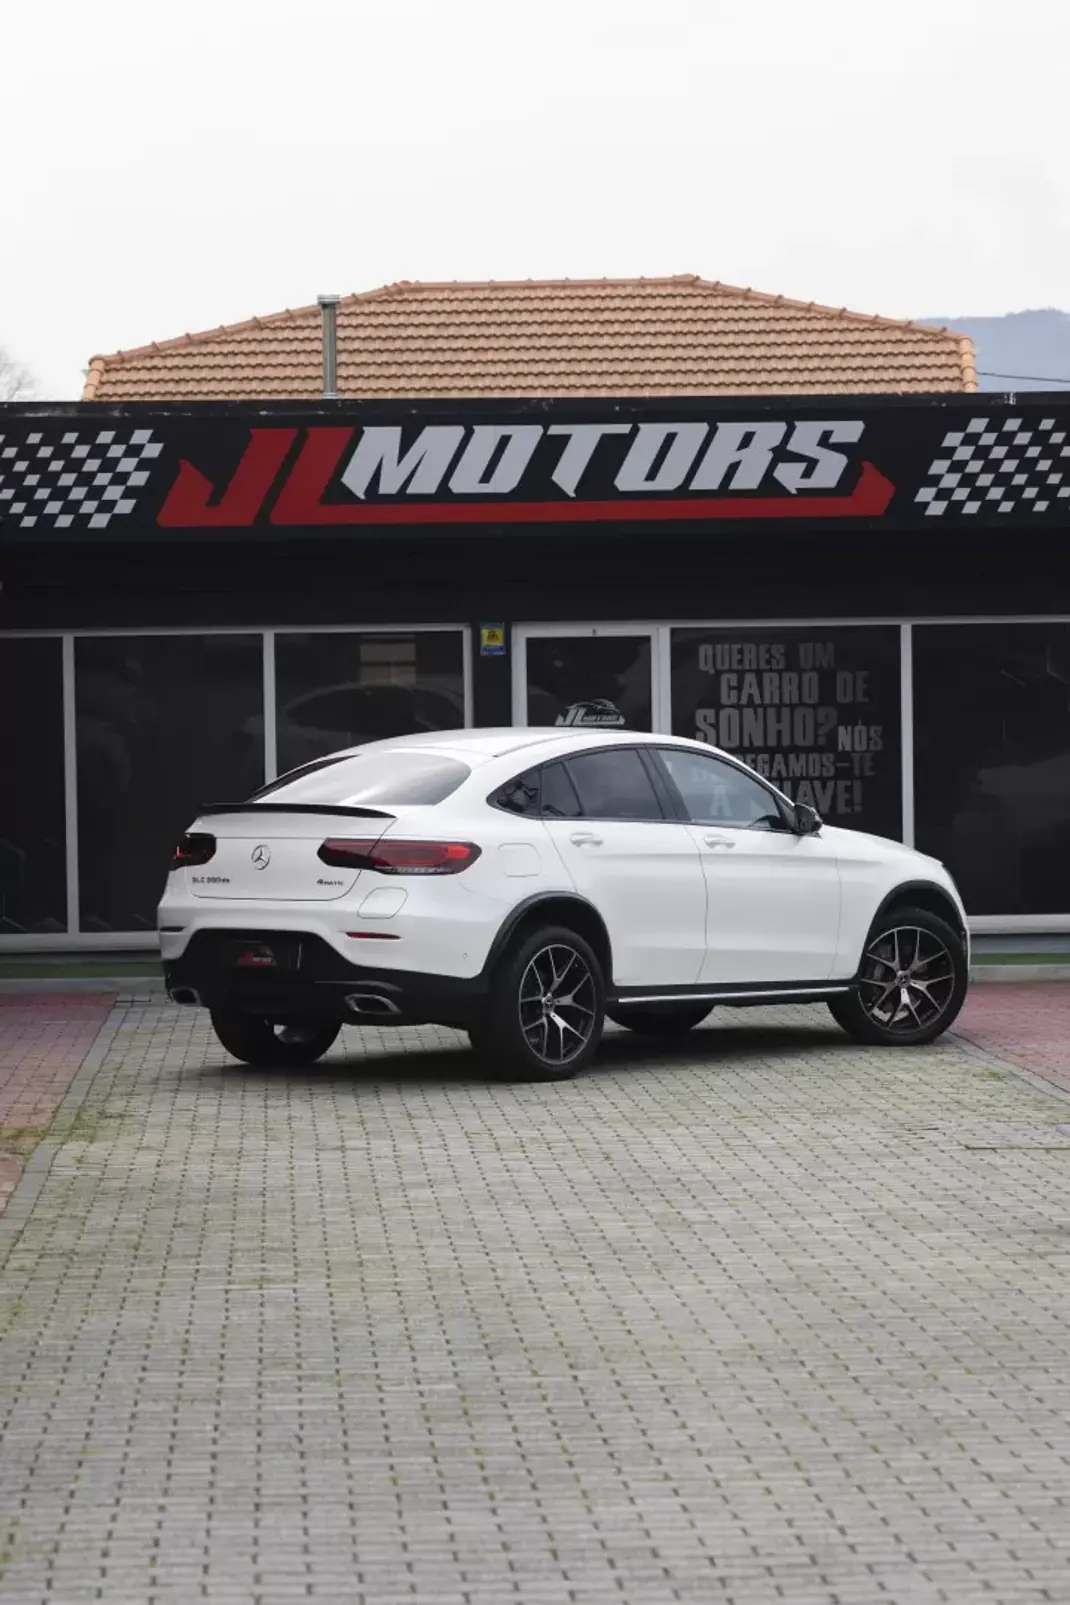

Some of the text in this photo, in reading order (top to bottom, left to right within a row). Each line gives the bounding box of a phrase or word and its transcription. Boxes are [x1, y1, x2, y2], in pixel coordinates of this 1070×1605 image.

[341, 420, 866, 499] MOTORS
[698, 642, 836, 675] QUERES UM
[720, 671, 870, 705] CARRO DE
[695, 706, 884, 752] SONHO? NÓS
